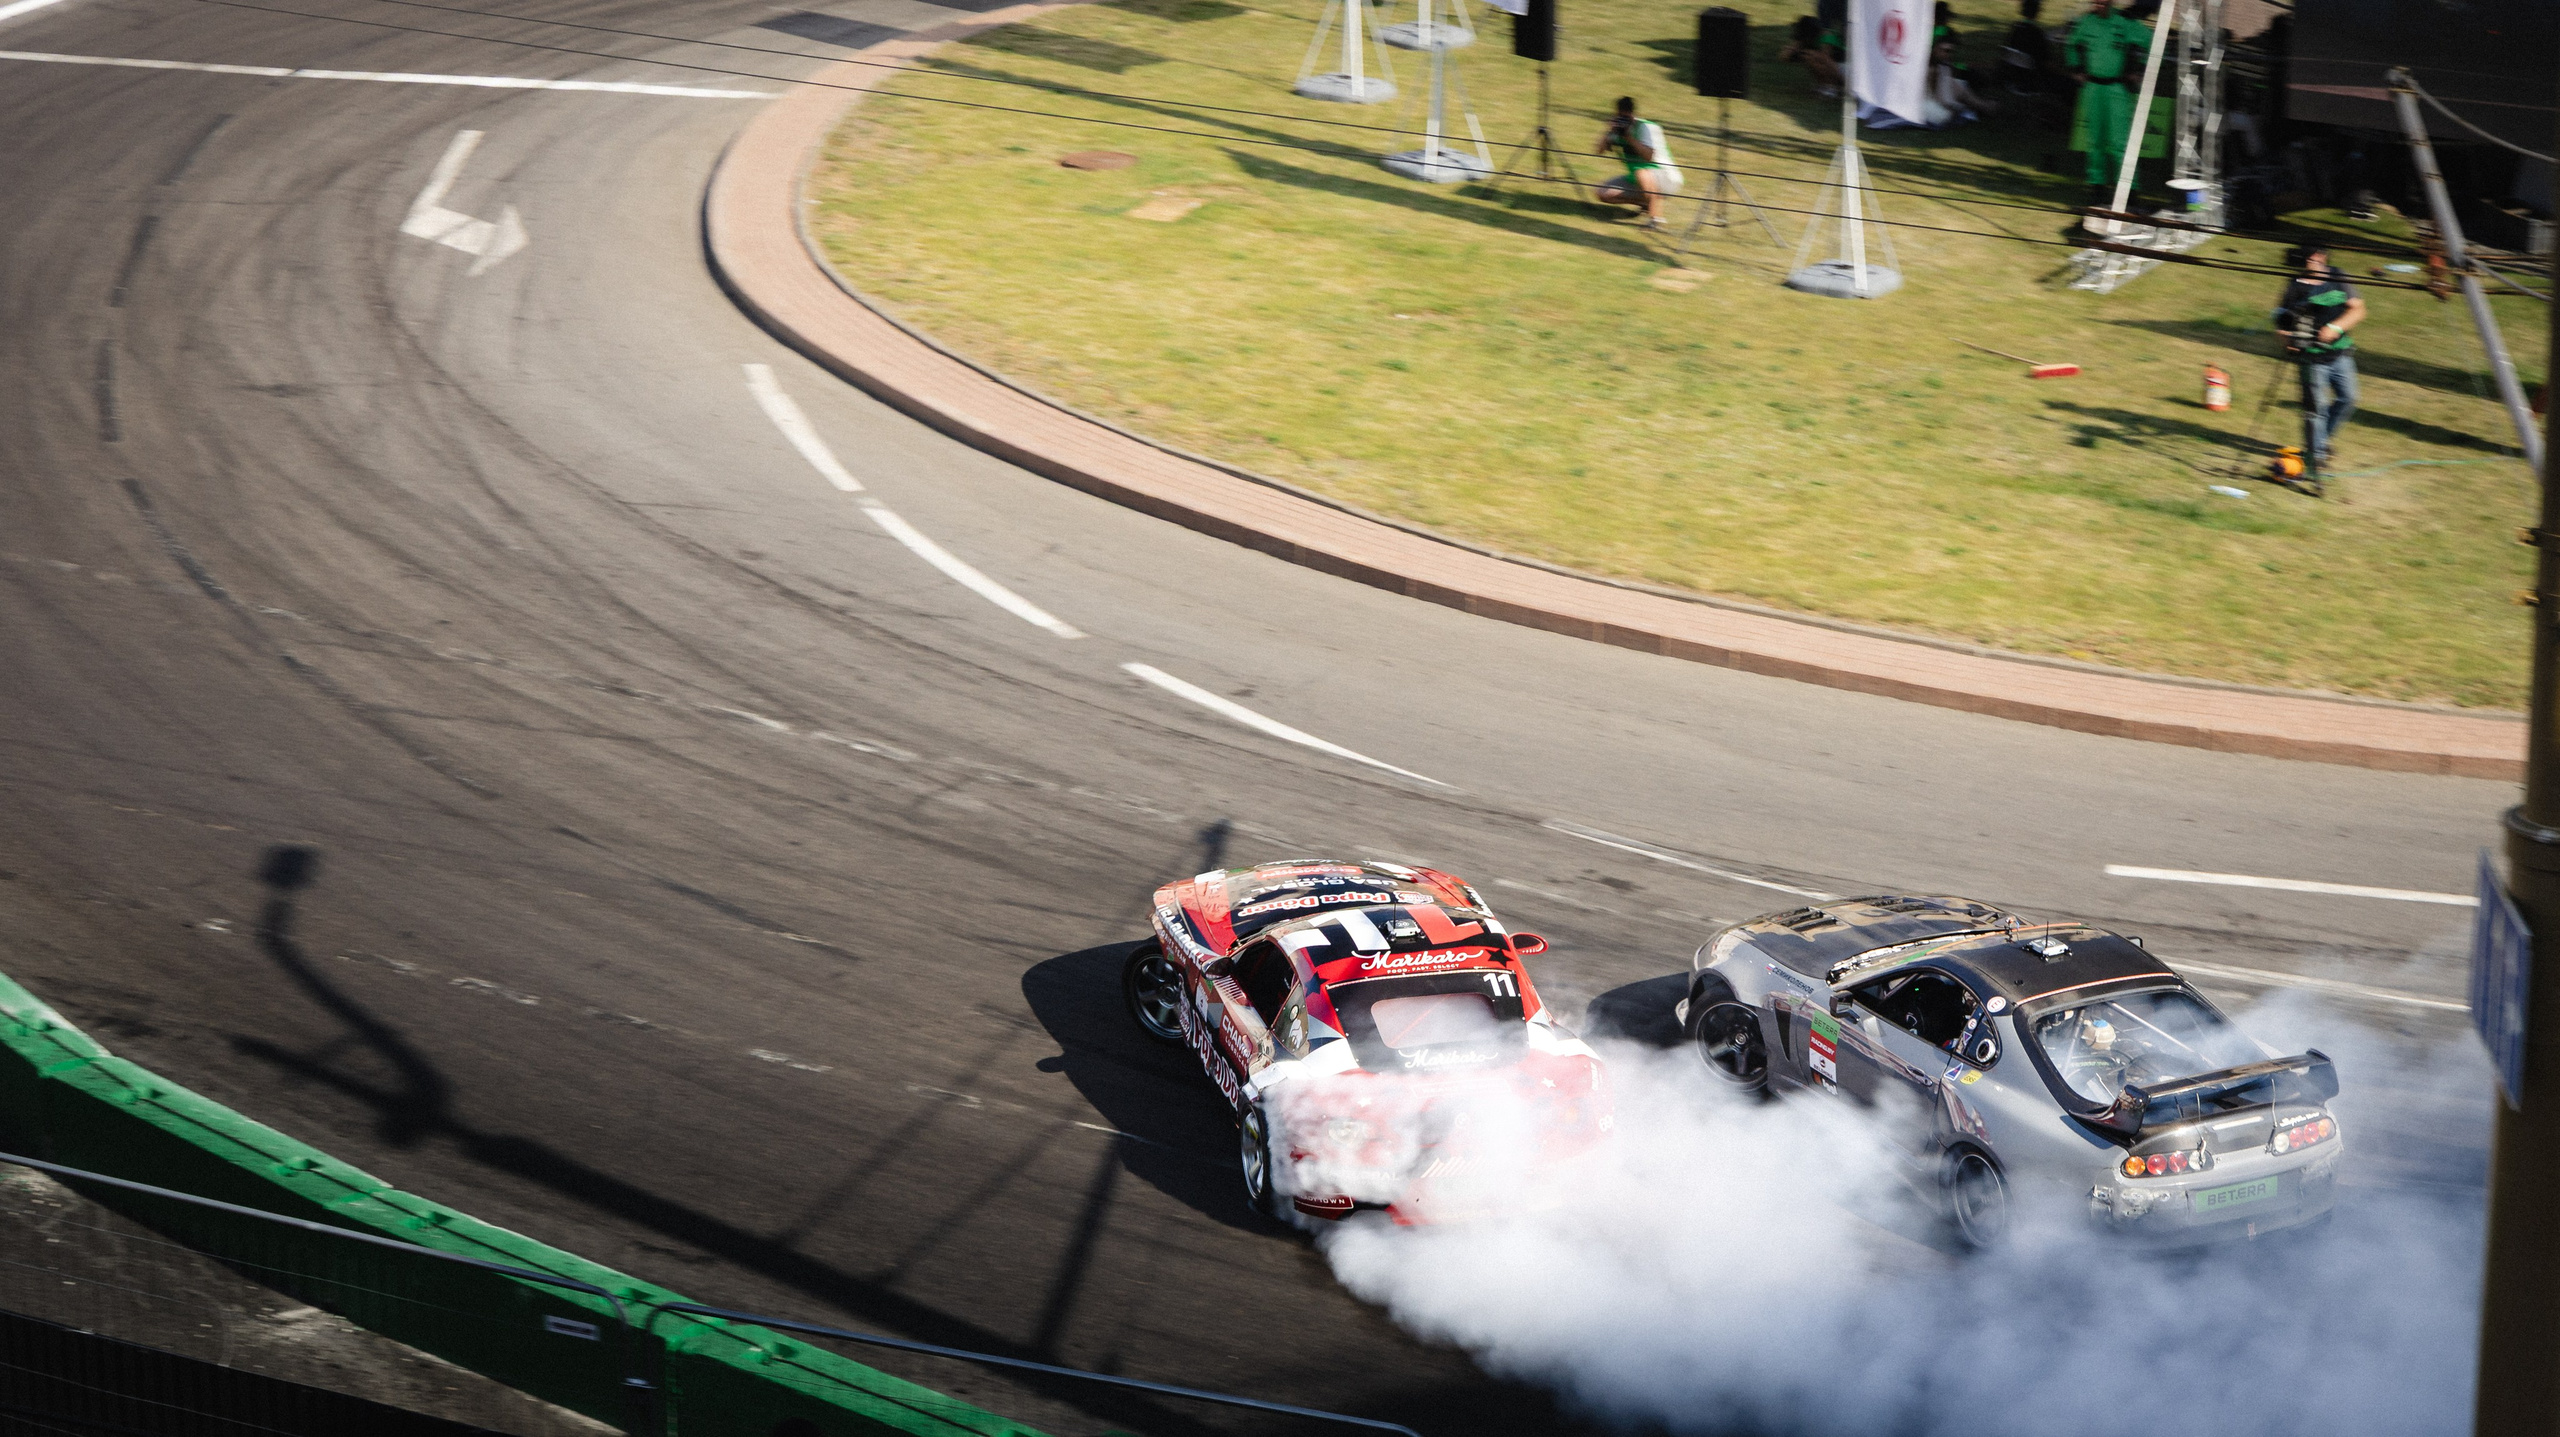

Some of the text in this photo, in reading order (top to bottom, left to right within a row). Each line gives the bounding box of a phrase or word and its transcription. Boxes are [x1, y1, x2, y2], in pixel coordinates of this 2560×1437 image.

[1250, 878, 1399, 894] USA GLOBAL
[1237, 895, 1320, 918] Döner
[1319, 891, 1391, 905] Papa
[1351, 950, 1484, 970] Marikaro
[1483, 973, 1517, 997] 11
[1398, 1049, 1499, 1069] Marikaro
[2207, 1183, 2267, 1206] BET.ERA
